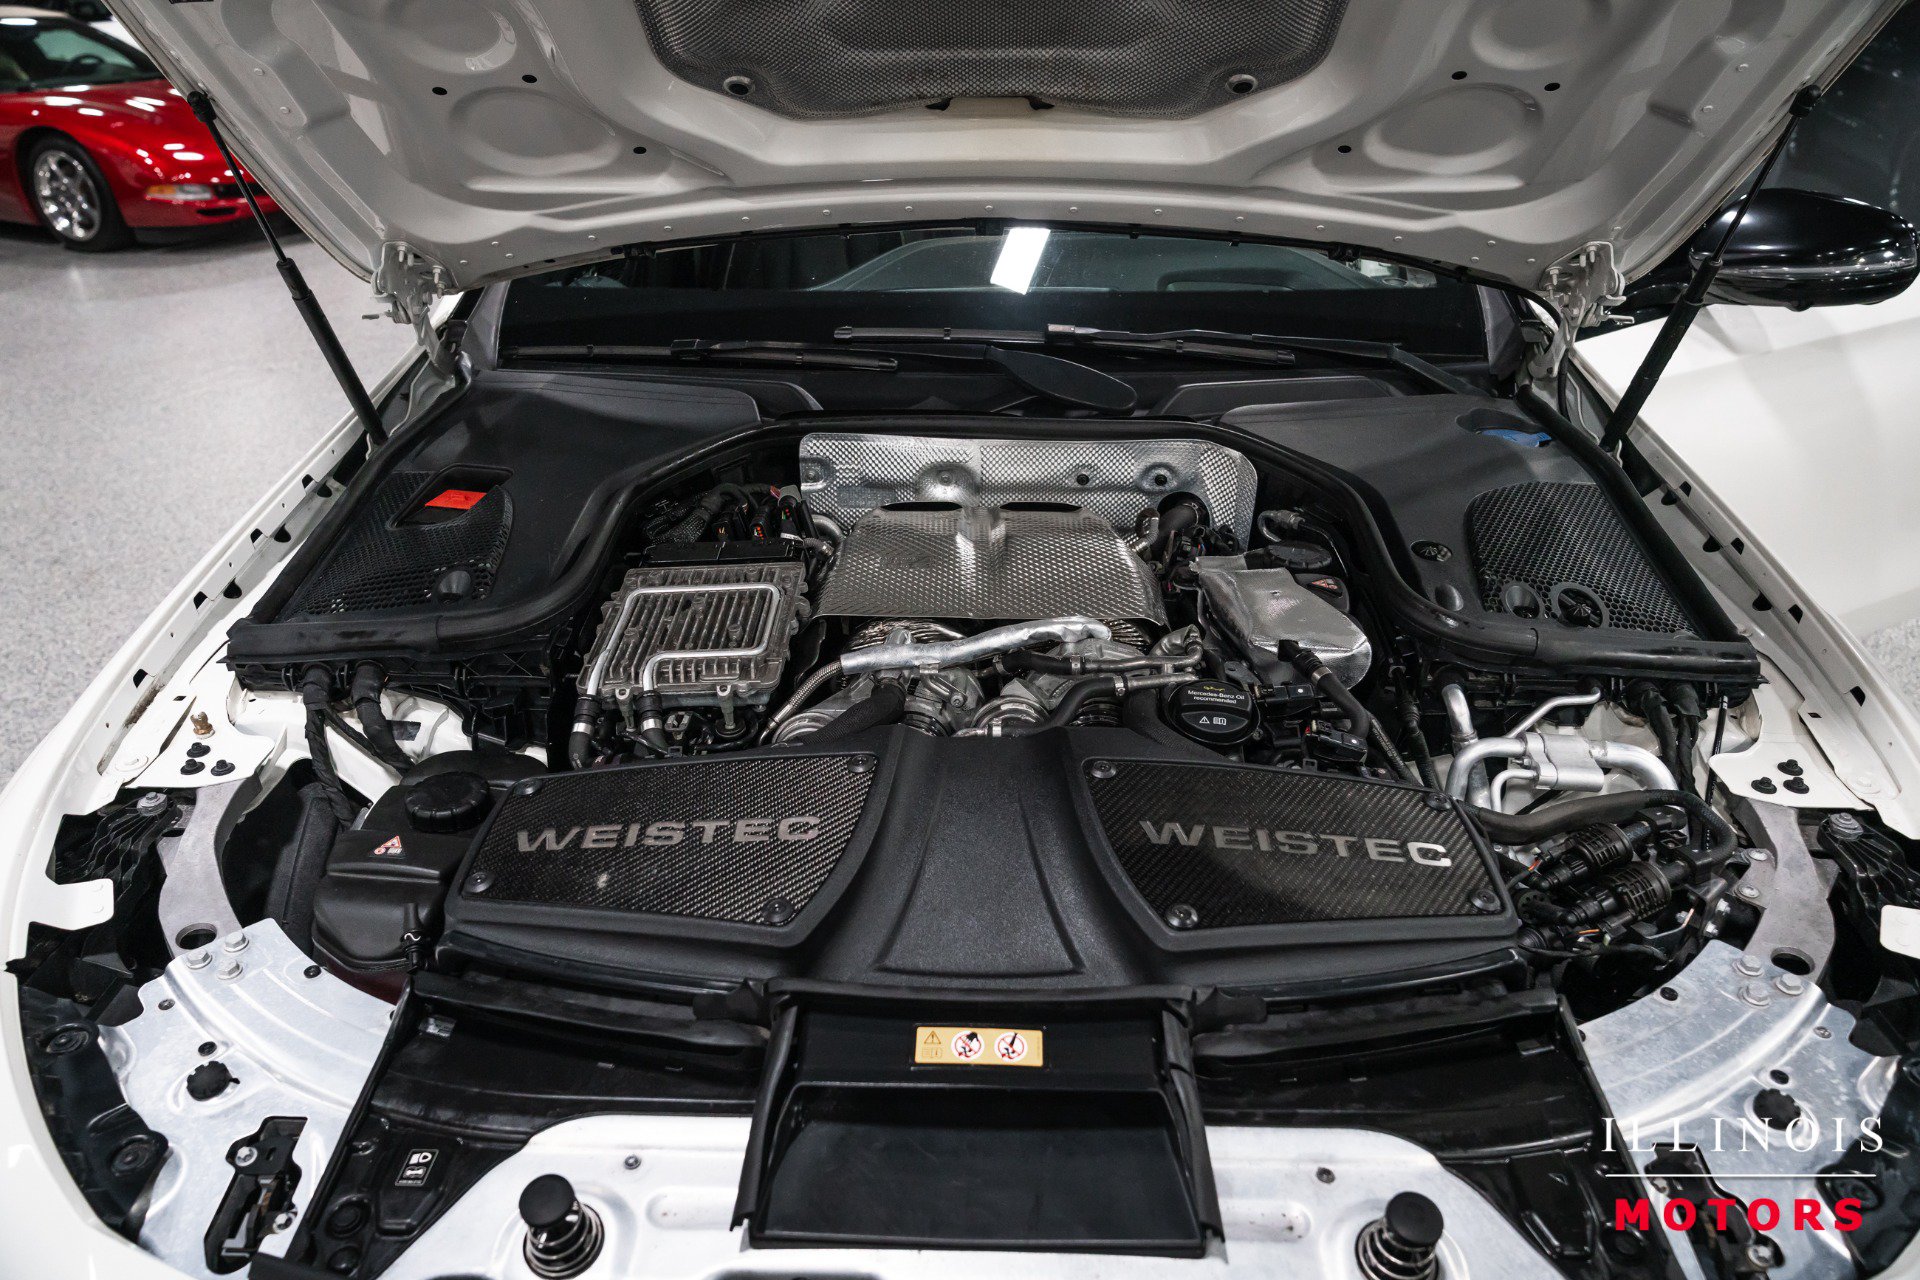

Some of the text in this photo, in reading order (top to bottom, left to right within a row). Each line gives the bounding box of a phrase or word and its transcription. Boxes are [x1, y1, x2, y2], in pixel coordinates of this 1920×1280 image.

[1188, 690, 1235, 699] Mercedes-Benz
[1193, 696, 1237, 704] recommended
[517, 816, 820, 852] WEISTEC
[1139, 820, 1452, 867] WEISTEC
